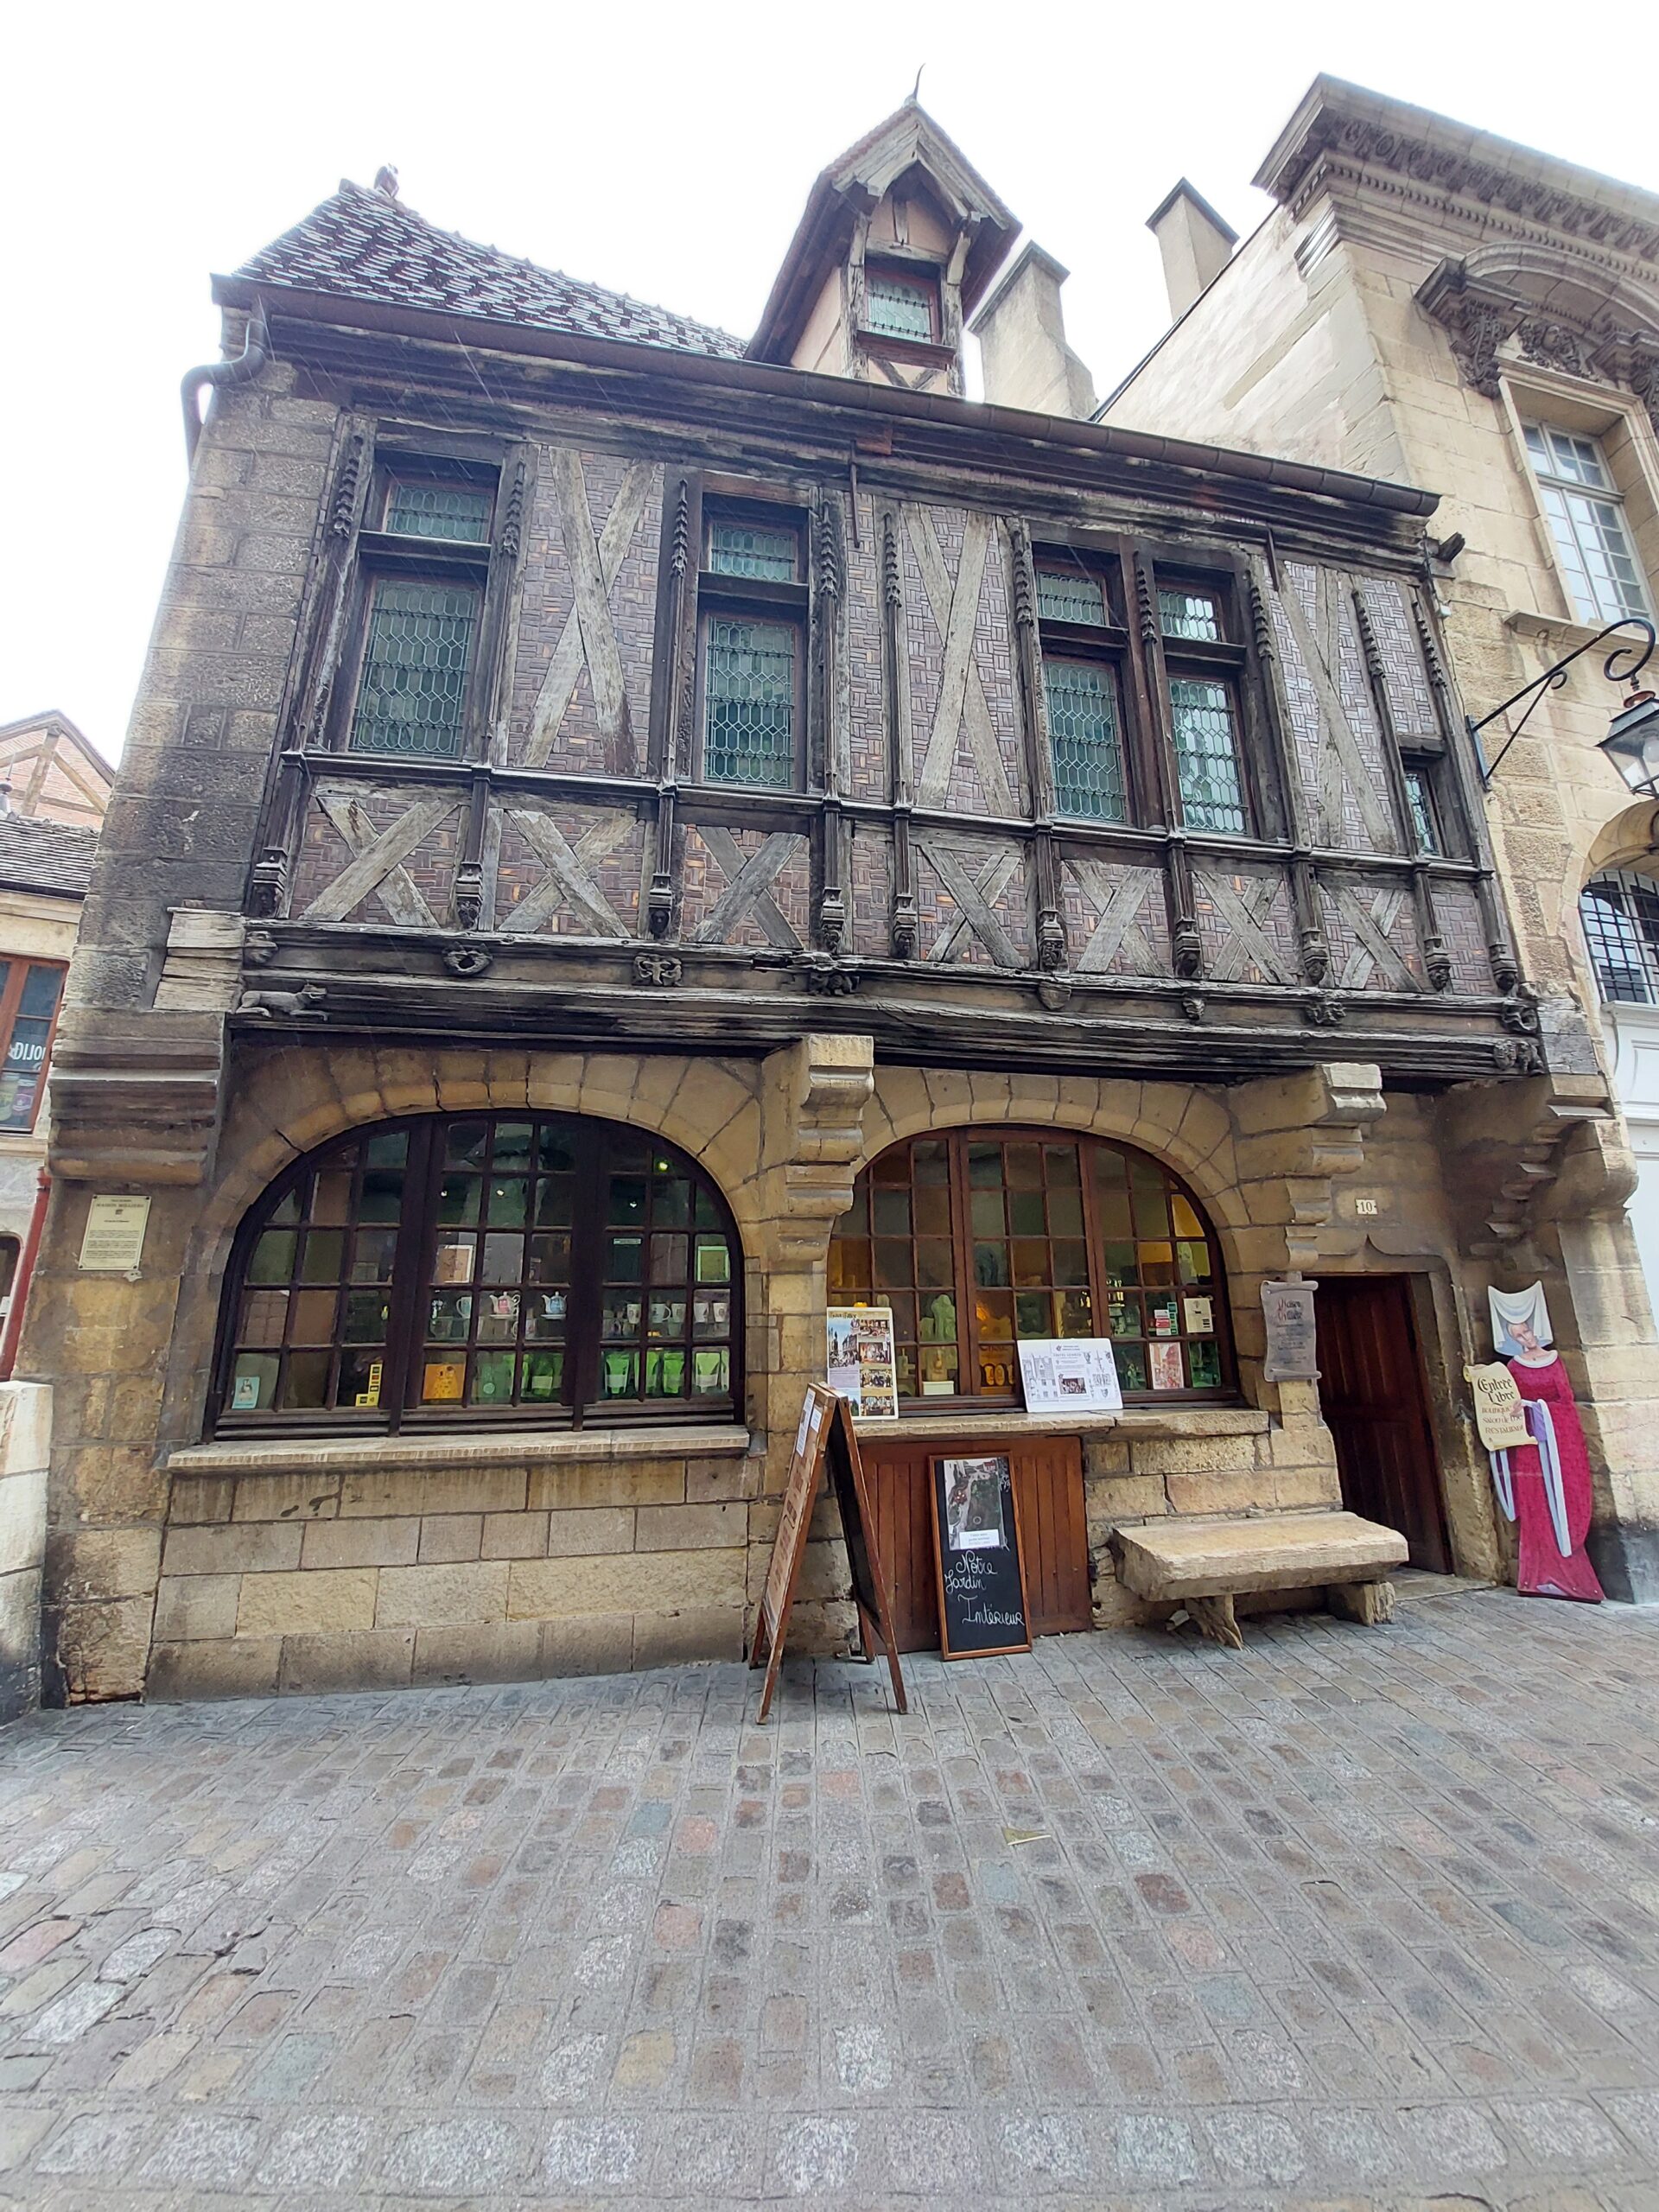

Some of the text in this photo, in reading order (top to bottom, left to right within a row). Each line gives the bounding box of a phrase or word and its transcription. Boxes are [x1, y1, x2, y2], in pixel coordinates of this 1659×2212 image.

[1360, 1201, 1373, 1212] 10
[956, 1550, 998, 1574] Notre
[944, 1569, 986, 1594] Jardin
